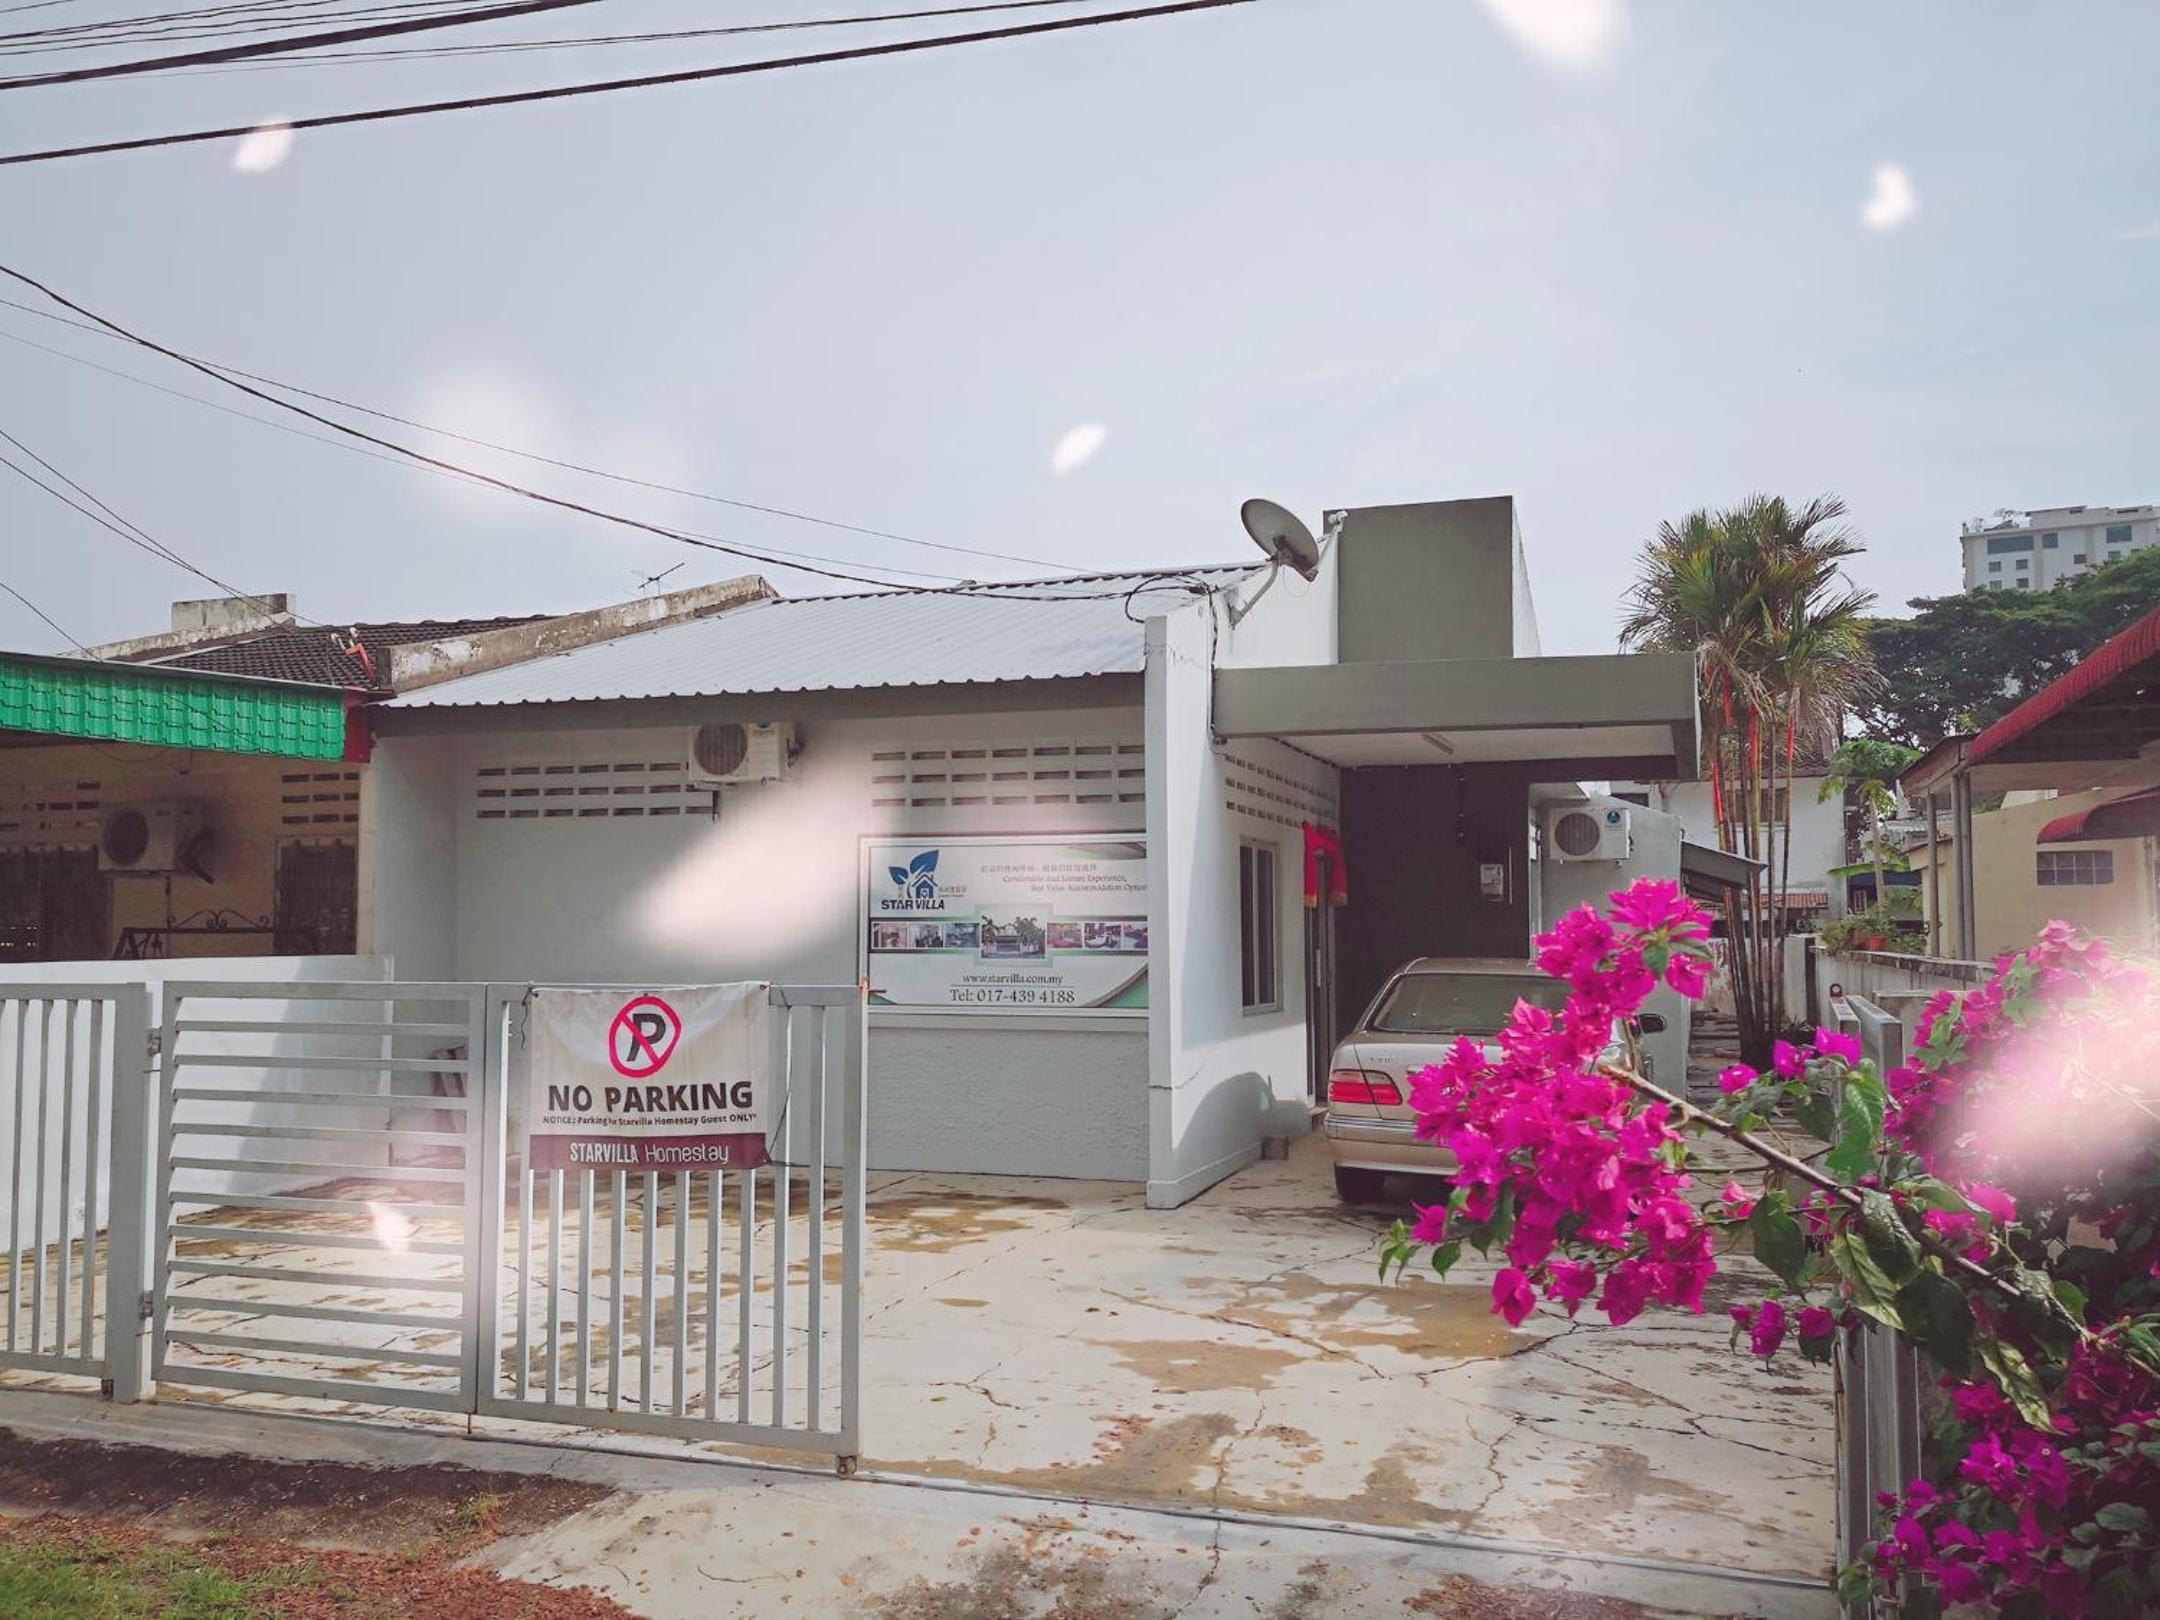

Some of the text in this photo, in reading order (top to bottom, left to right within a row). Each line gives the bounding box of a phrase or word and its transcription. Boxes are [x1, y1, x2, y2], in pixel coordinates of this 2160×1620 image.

[881, 899, 945, 910] STAR VILLA
[962, 973, 1063, 985] www.starvilla.com.my
[950, 988, 1075, 1003] Tel: 017-439 4188
[548, 1081, 753, 1113] NO PARKING
[577, 1116, 608, 1127] Parking
[654, 1116, 699, 1127] Homestay
[701, 1115, 727, 1124] Guest
[569, 1143, 729, 1165] STARVILLA Homestay
